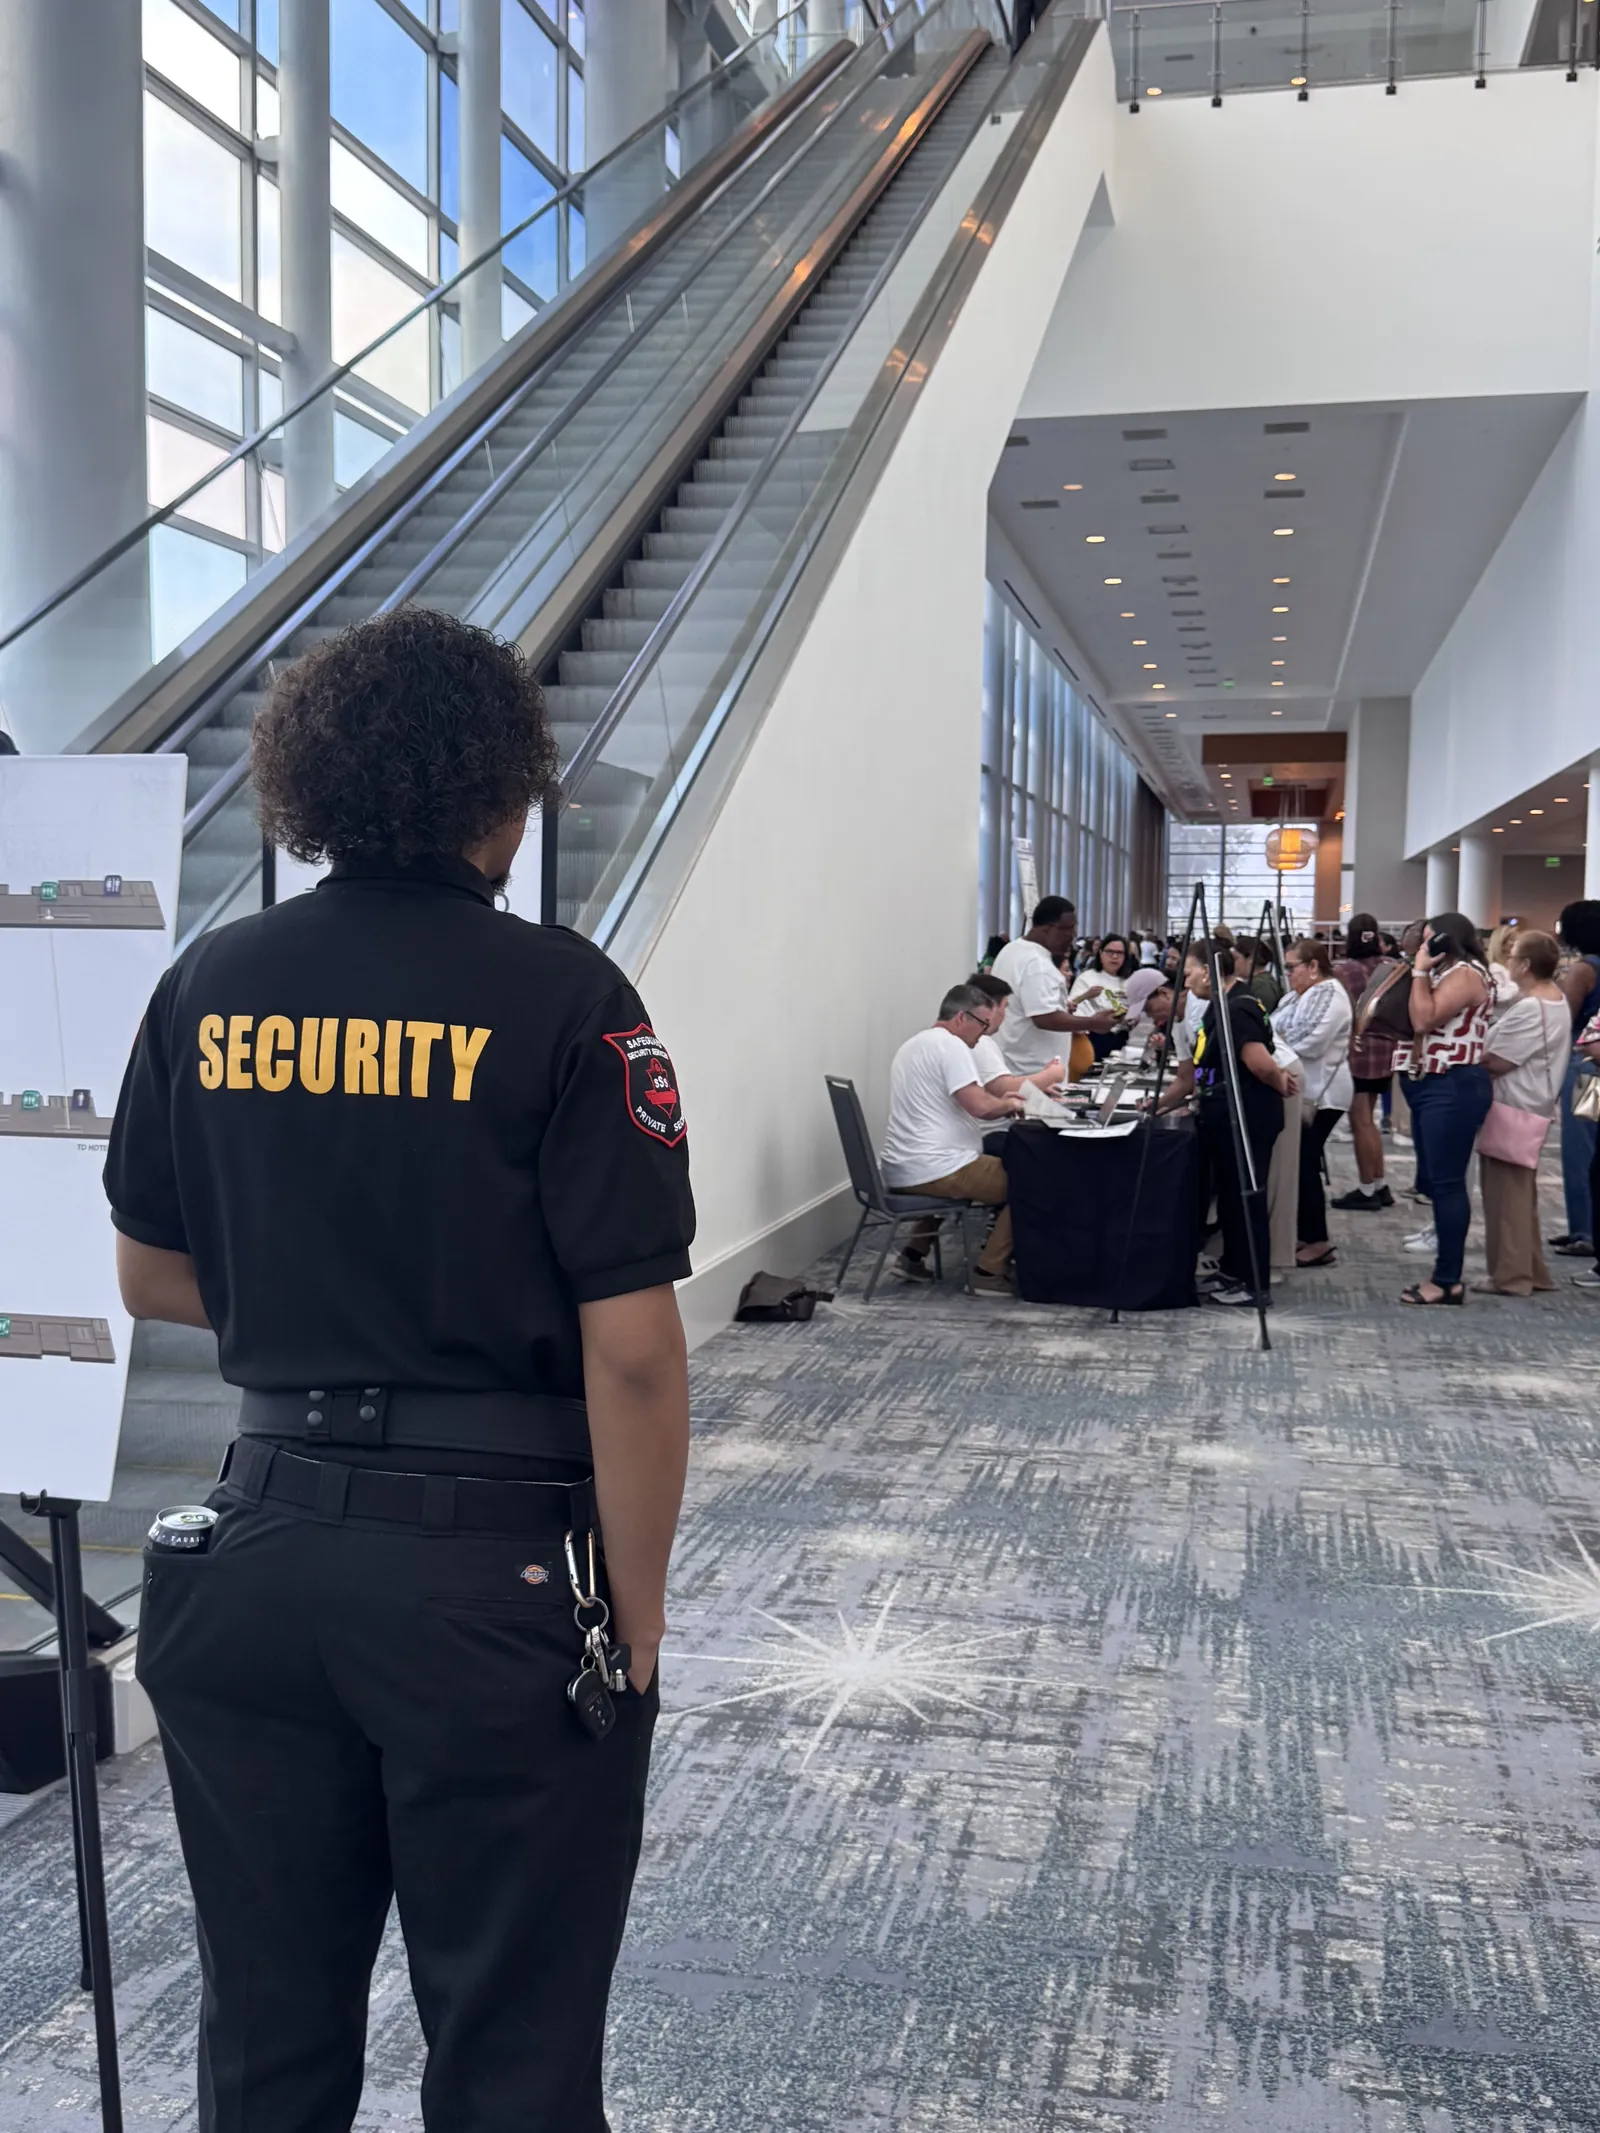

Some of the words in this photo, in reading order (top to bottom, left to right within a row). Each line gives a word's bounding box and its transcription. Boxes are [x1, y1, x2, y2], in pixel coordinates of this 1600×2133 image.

[199, 1014, 492, 1101] SECURITY
[627, 1048, 651, 1061] SECURITY
[635, 1105, 667, 1133] PRIVATE
[88, 1144, 108, 1152] HOTE
